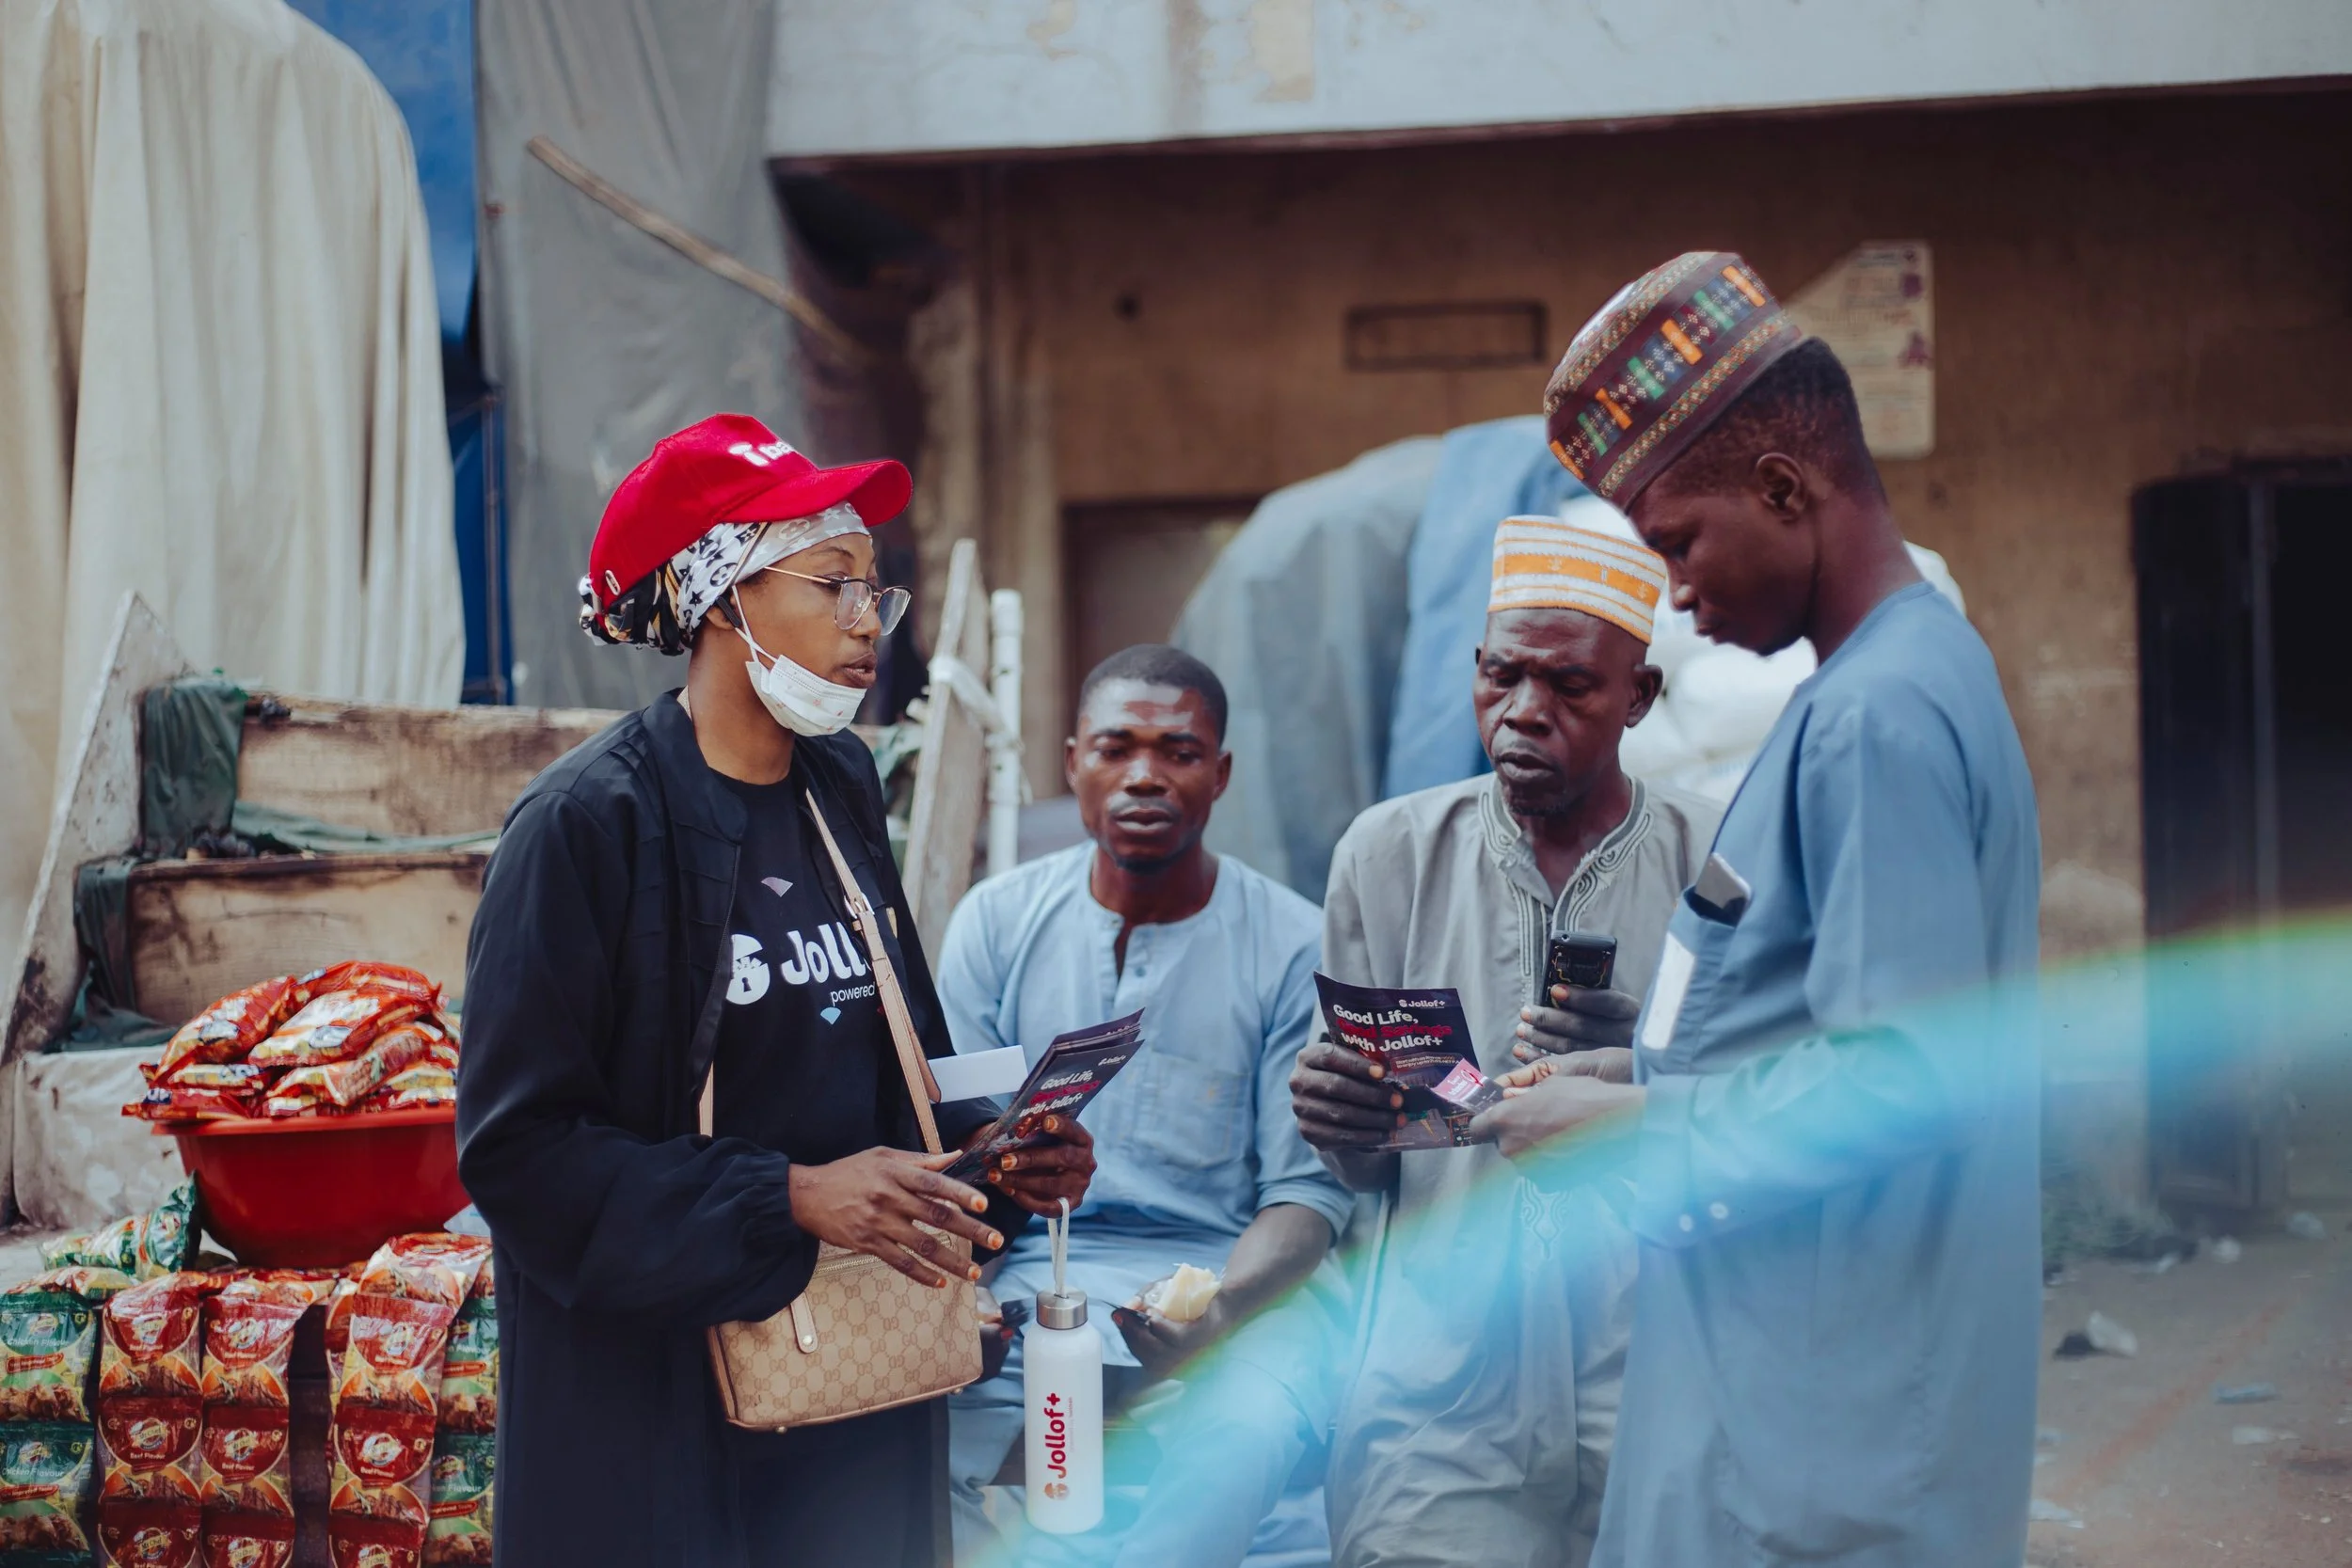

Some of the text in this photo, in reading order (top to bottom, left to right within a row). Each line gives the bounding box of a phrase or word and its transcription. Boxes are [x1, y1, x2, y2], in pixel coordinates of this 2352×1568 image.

[781, 922, 872, 985] Joll
[831, 985, 875, 1006] powered
[1333, 1005, 1418, 1025] Good Life,
[1341, 1032, 1443, 1052] with Jollof+
[1041, 1073, 1074, 1090] Good
[1043, 1392, 1067, 1479] Jollof+
